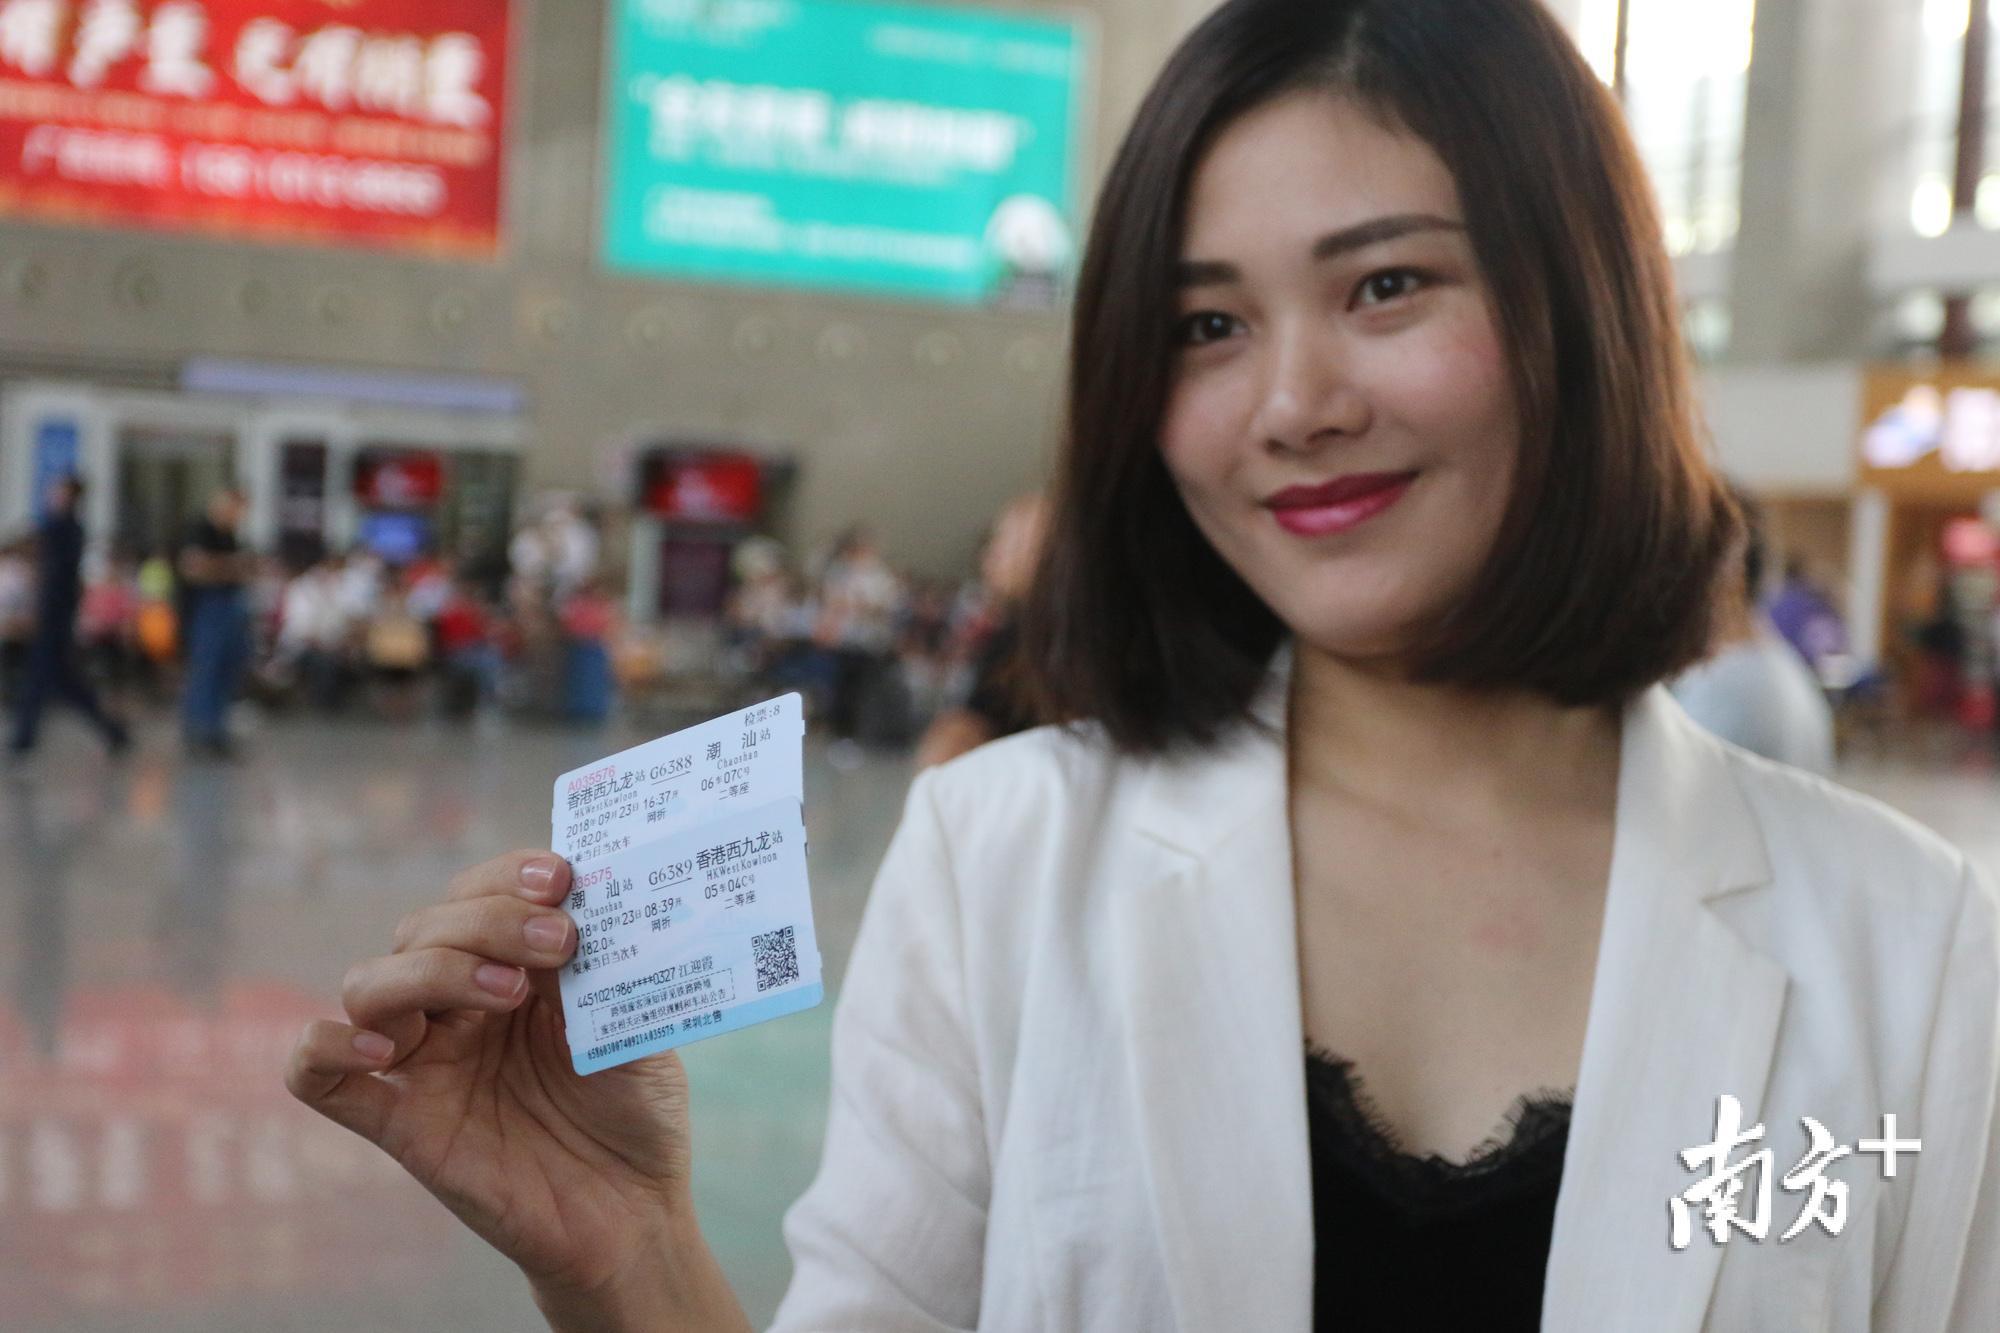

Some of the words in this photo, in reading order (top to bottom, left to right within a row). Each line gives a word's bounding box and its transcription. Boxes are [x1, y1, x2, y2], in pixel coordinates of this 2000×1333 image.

[744, 704, 781, 727] 检票:8
[650, 755, 693, 780] G6388
[717, 750, 758, 770] Chaoshan
[568, 764, 616, 793] A035576
[719, 782, 750, 800] 二等座
[649, 859, 693, 885] G6389
[707, 853, 778, 881] HKWestKowloon
[583, 901, 623, 919] Chaoshan
[725, 890, 756, 909] 二等座
[681, 1009, 722, 1031] 深圳北售
